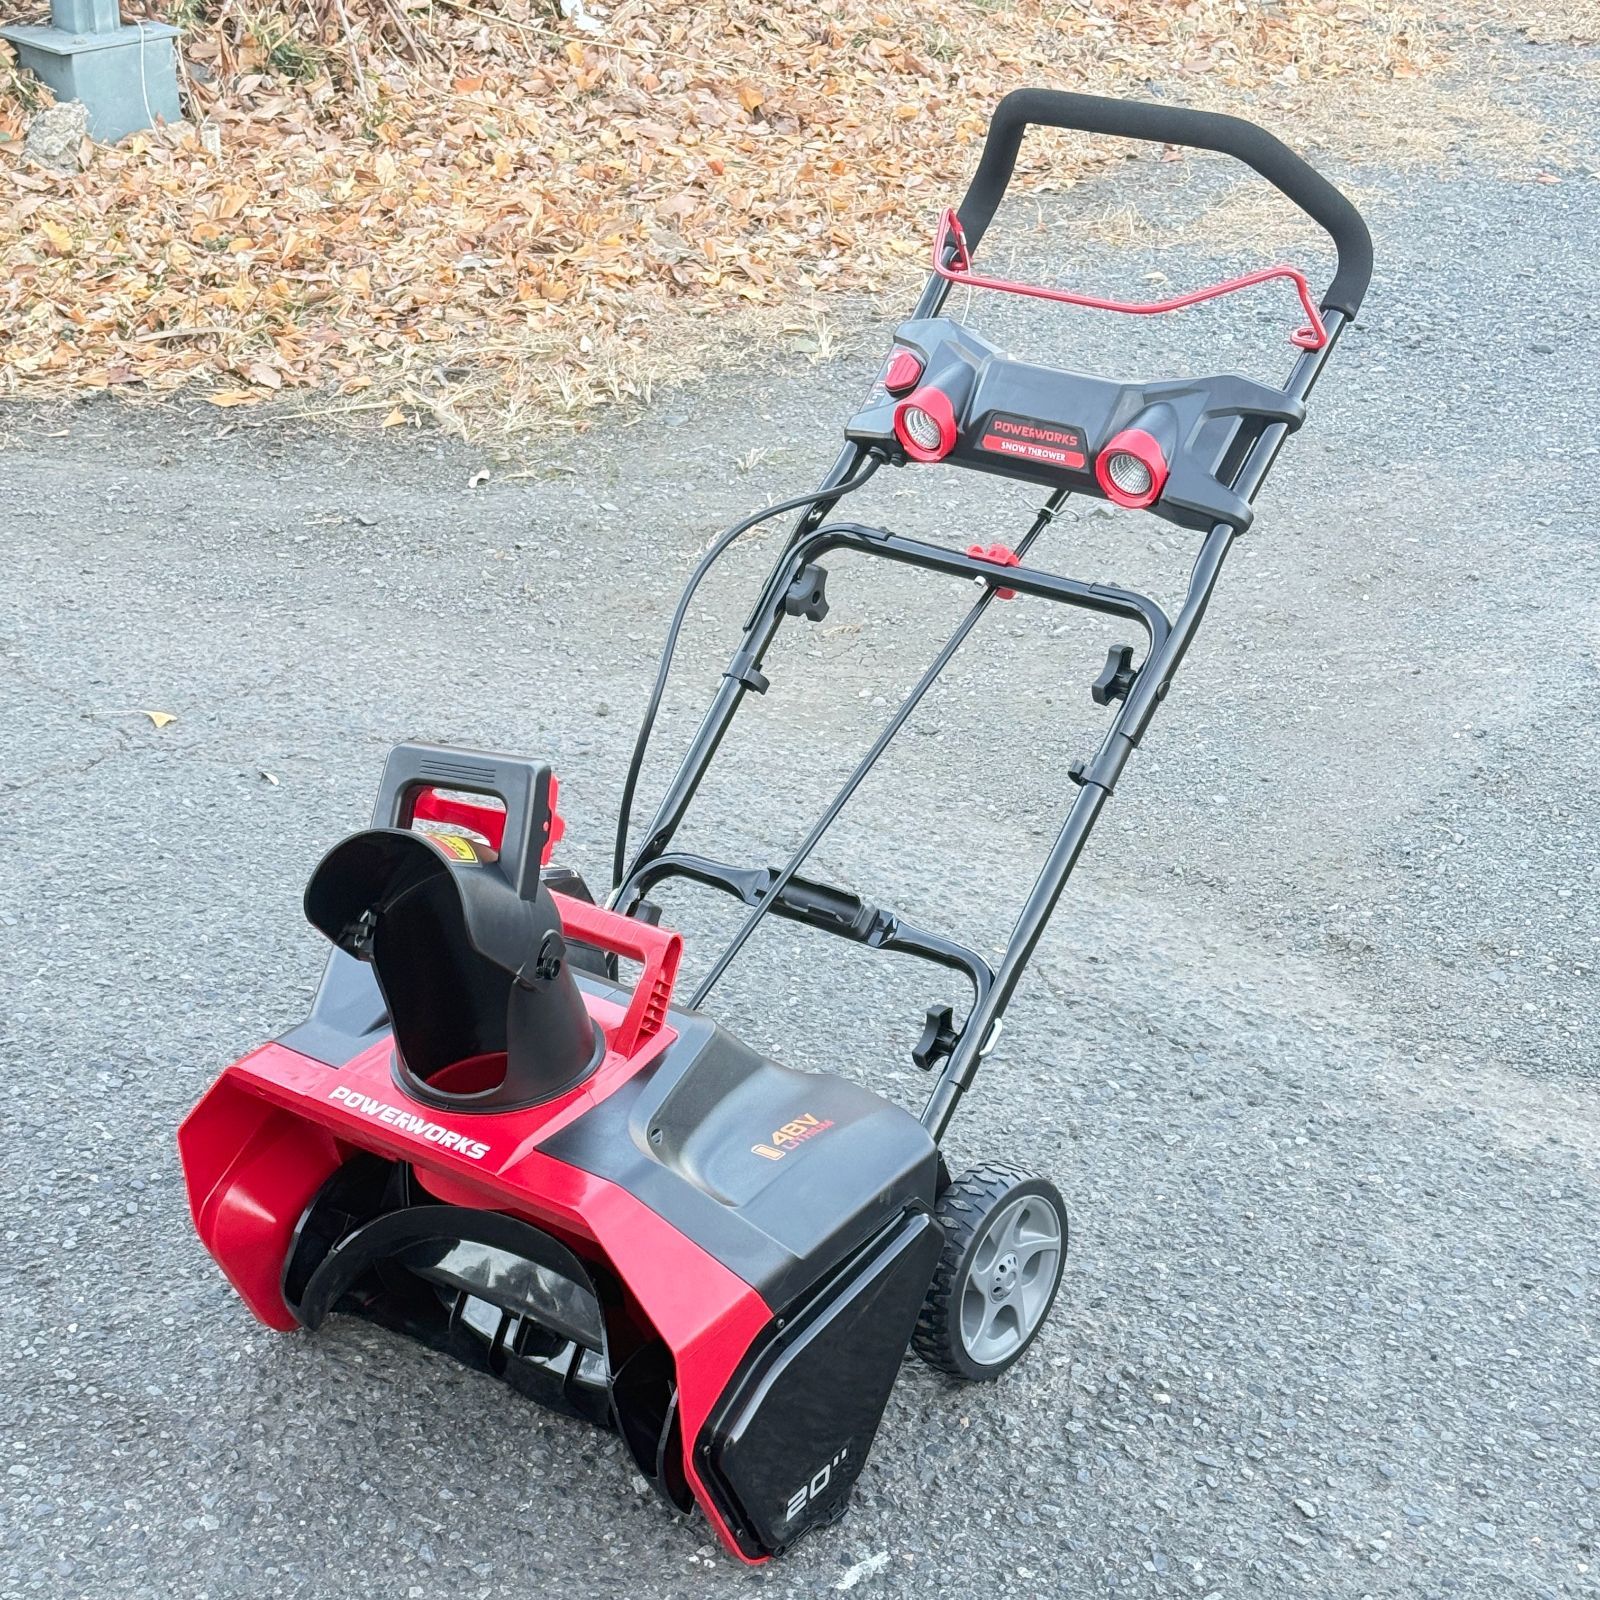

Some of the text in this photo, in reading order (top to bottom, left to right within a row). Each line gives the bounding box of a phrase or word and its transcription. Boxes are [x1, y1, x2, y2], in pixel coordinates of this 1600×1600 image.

[994, 420, 1078, 446] POWERWORKS
[1000, 441, 1066, 462] SNOW THROWER
[327, 1085, 491, 1160] POWERWORKS
[771, 1112, 820, 1146] 48V
